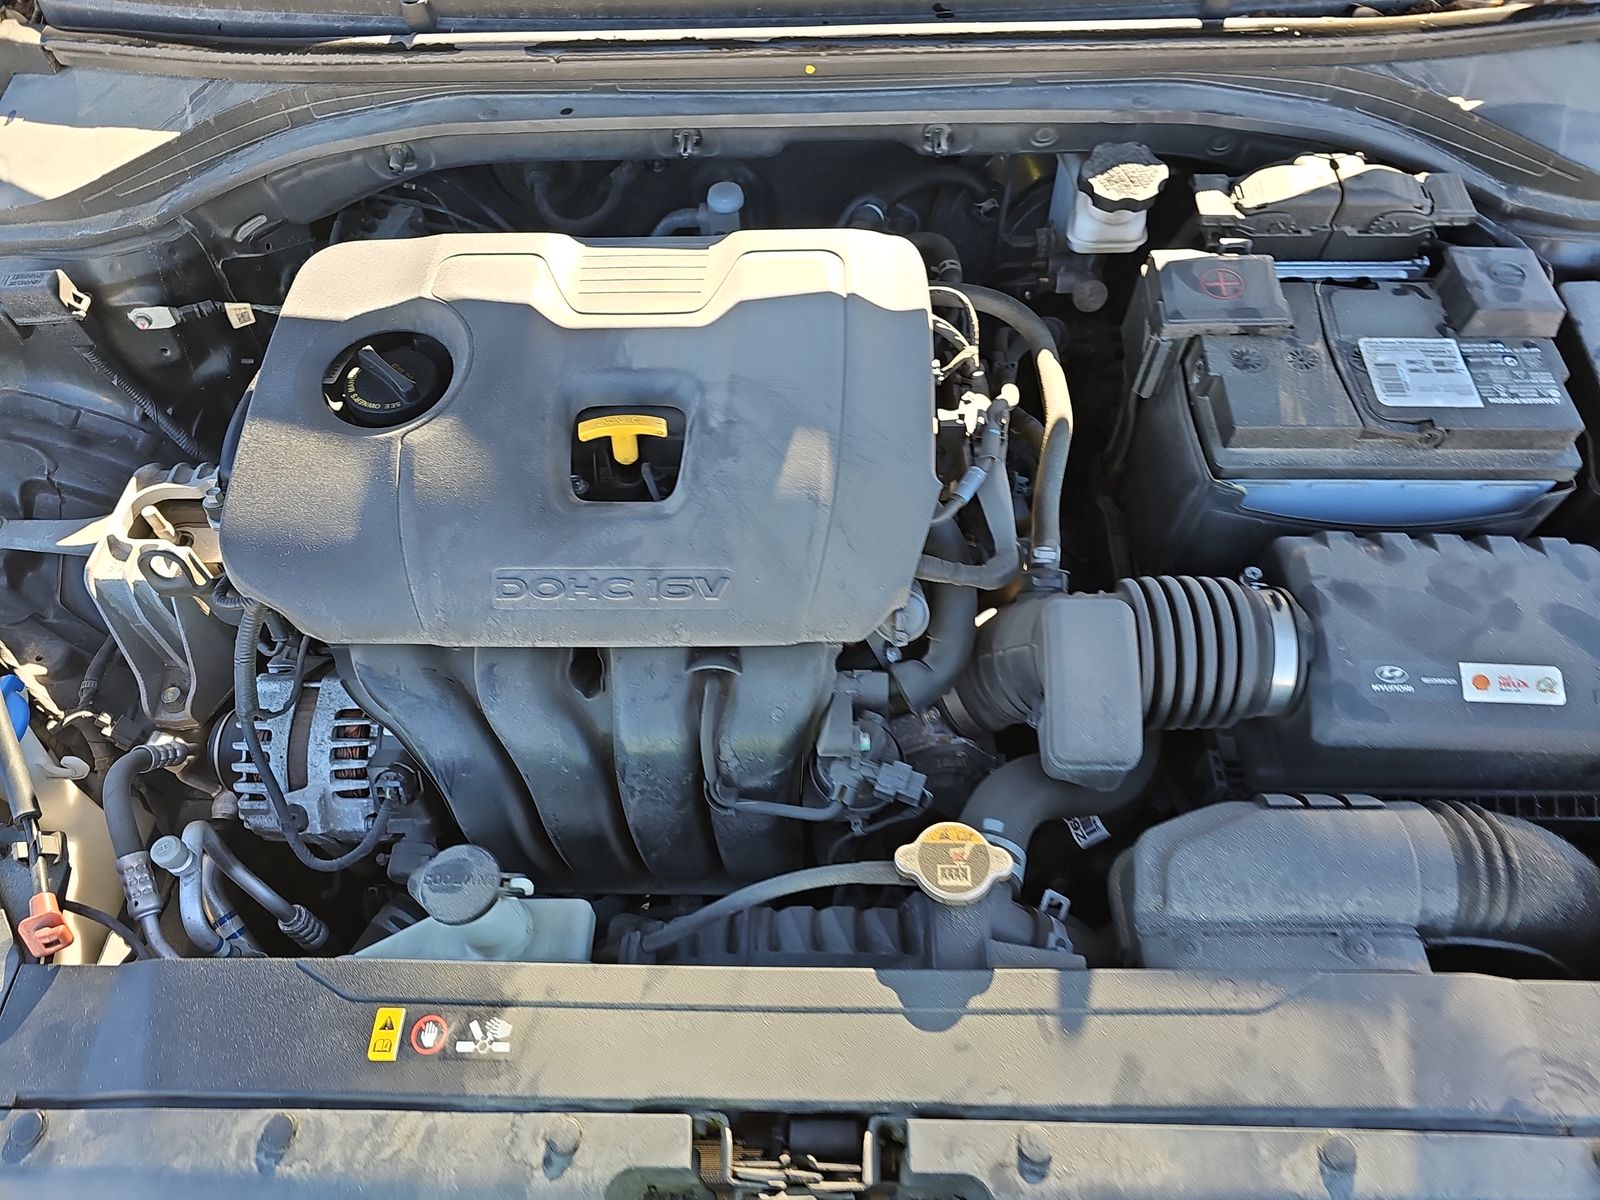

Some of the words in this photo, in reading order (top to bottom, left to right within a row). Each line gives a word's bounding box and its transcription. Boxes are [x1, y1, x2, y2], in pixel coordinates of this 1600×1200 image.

[384, 401, 401, 410] SEE
[496, 576, 634, 601] DOHC
[647, 576, 732, 601] 16V
